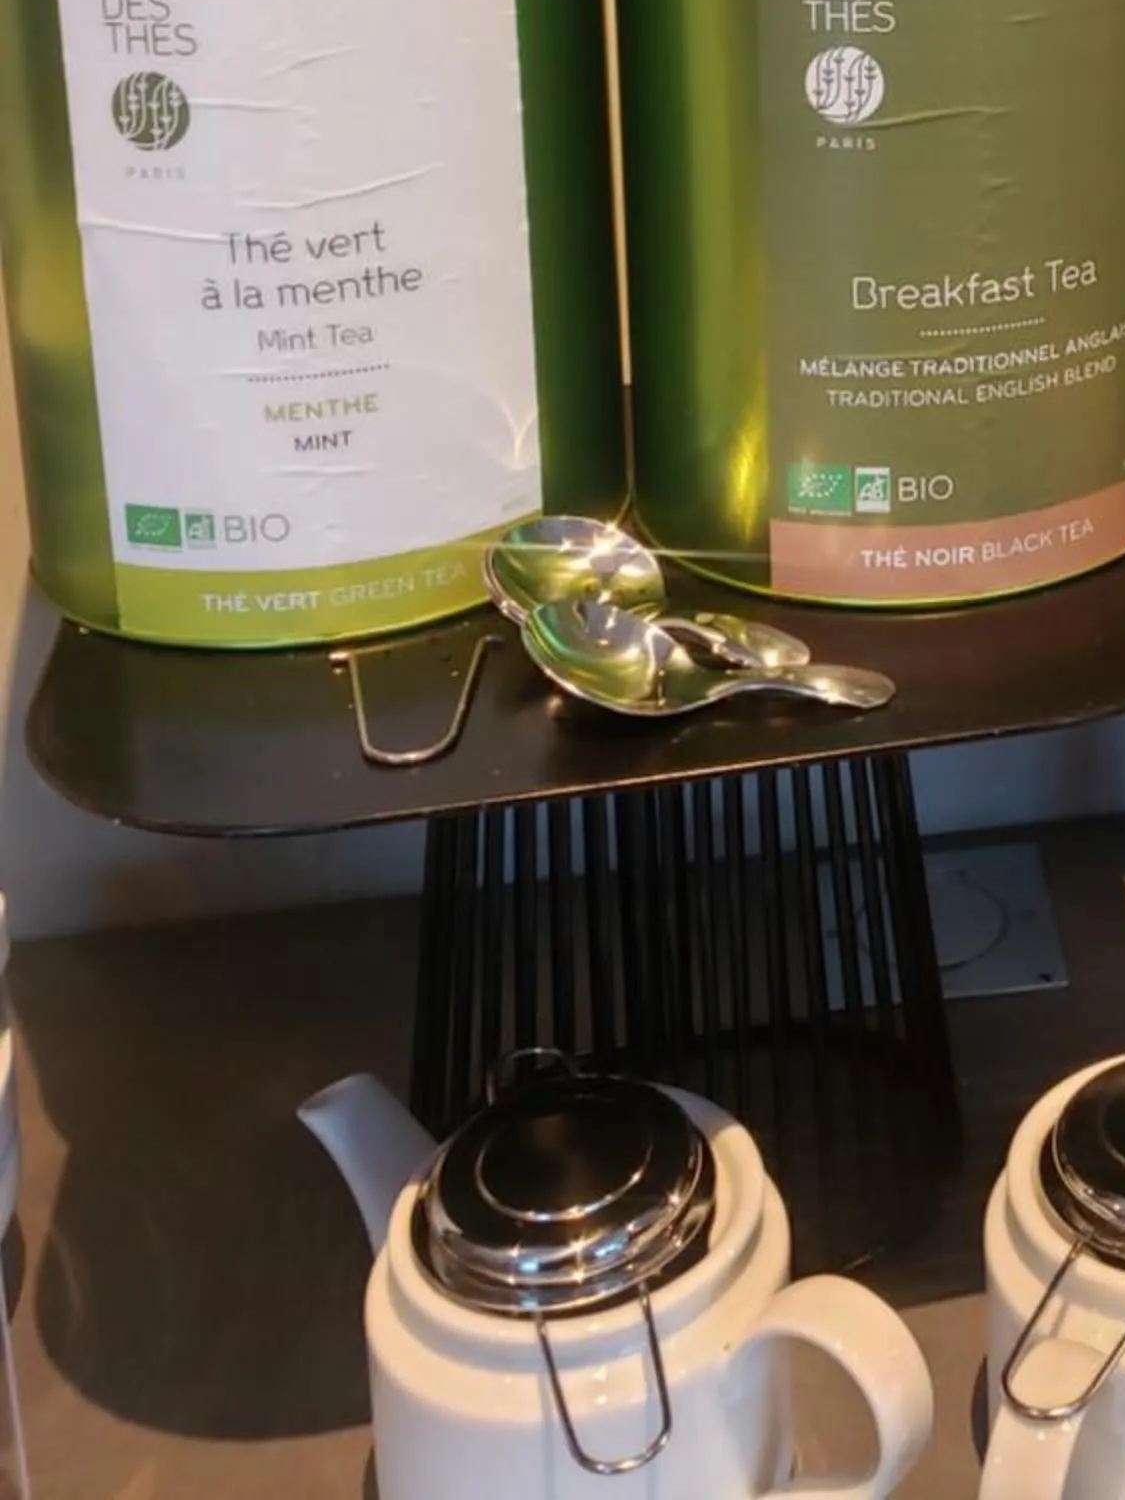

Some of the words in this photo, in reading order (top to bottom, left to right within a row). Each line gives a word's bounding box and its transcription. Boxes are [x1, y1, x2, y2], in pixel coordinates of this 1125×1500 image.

[816, 136, 877, 150] PARIS
[222, 230, 292, 264] Thé
[306, 221, 387, 260] vert
[201, 278, 222, 310] à
[234, 278, 264, 309] la
[277, 266, 423, 308] menthe
[852, 266, 1036, 310] Breakfast
[1044, 258, 1098, 293] Tea
[257, 327, 315, 351] Mint
[326, 324, 375, 348] Tea
[800, 355, 905, 378] MÉLANGE
[909, 343, 1060, 377] TRADITIONNEL
[826, 387, 970, 408] TRADITIONAL
[975, 372, 1058, 403] ENGLISH
[1063, 354, 1118, 387] BLEND
[264, 393, 380, 423] MENTHE
[294, 430, 353, 452] MINT
[897, 474, 954, 502] BIO
[223, 513, 291, 544] BIO
[861, 545, 908, 568] THÉ
[915, 546, 976, 567] NOIR
[981, 529, 1054, 563] BLACK
[1058, 517, 1096, 543] TEA
[203, 591, 250, 613] THÉ
[254, 590, 321, 612] VERT
[330, 576, 416, 607] GREEN
[424, 561, 468, 588] TEA
